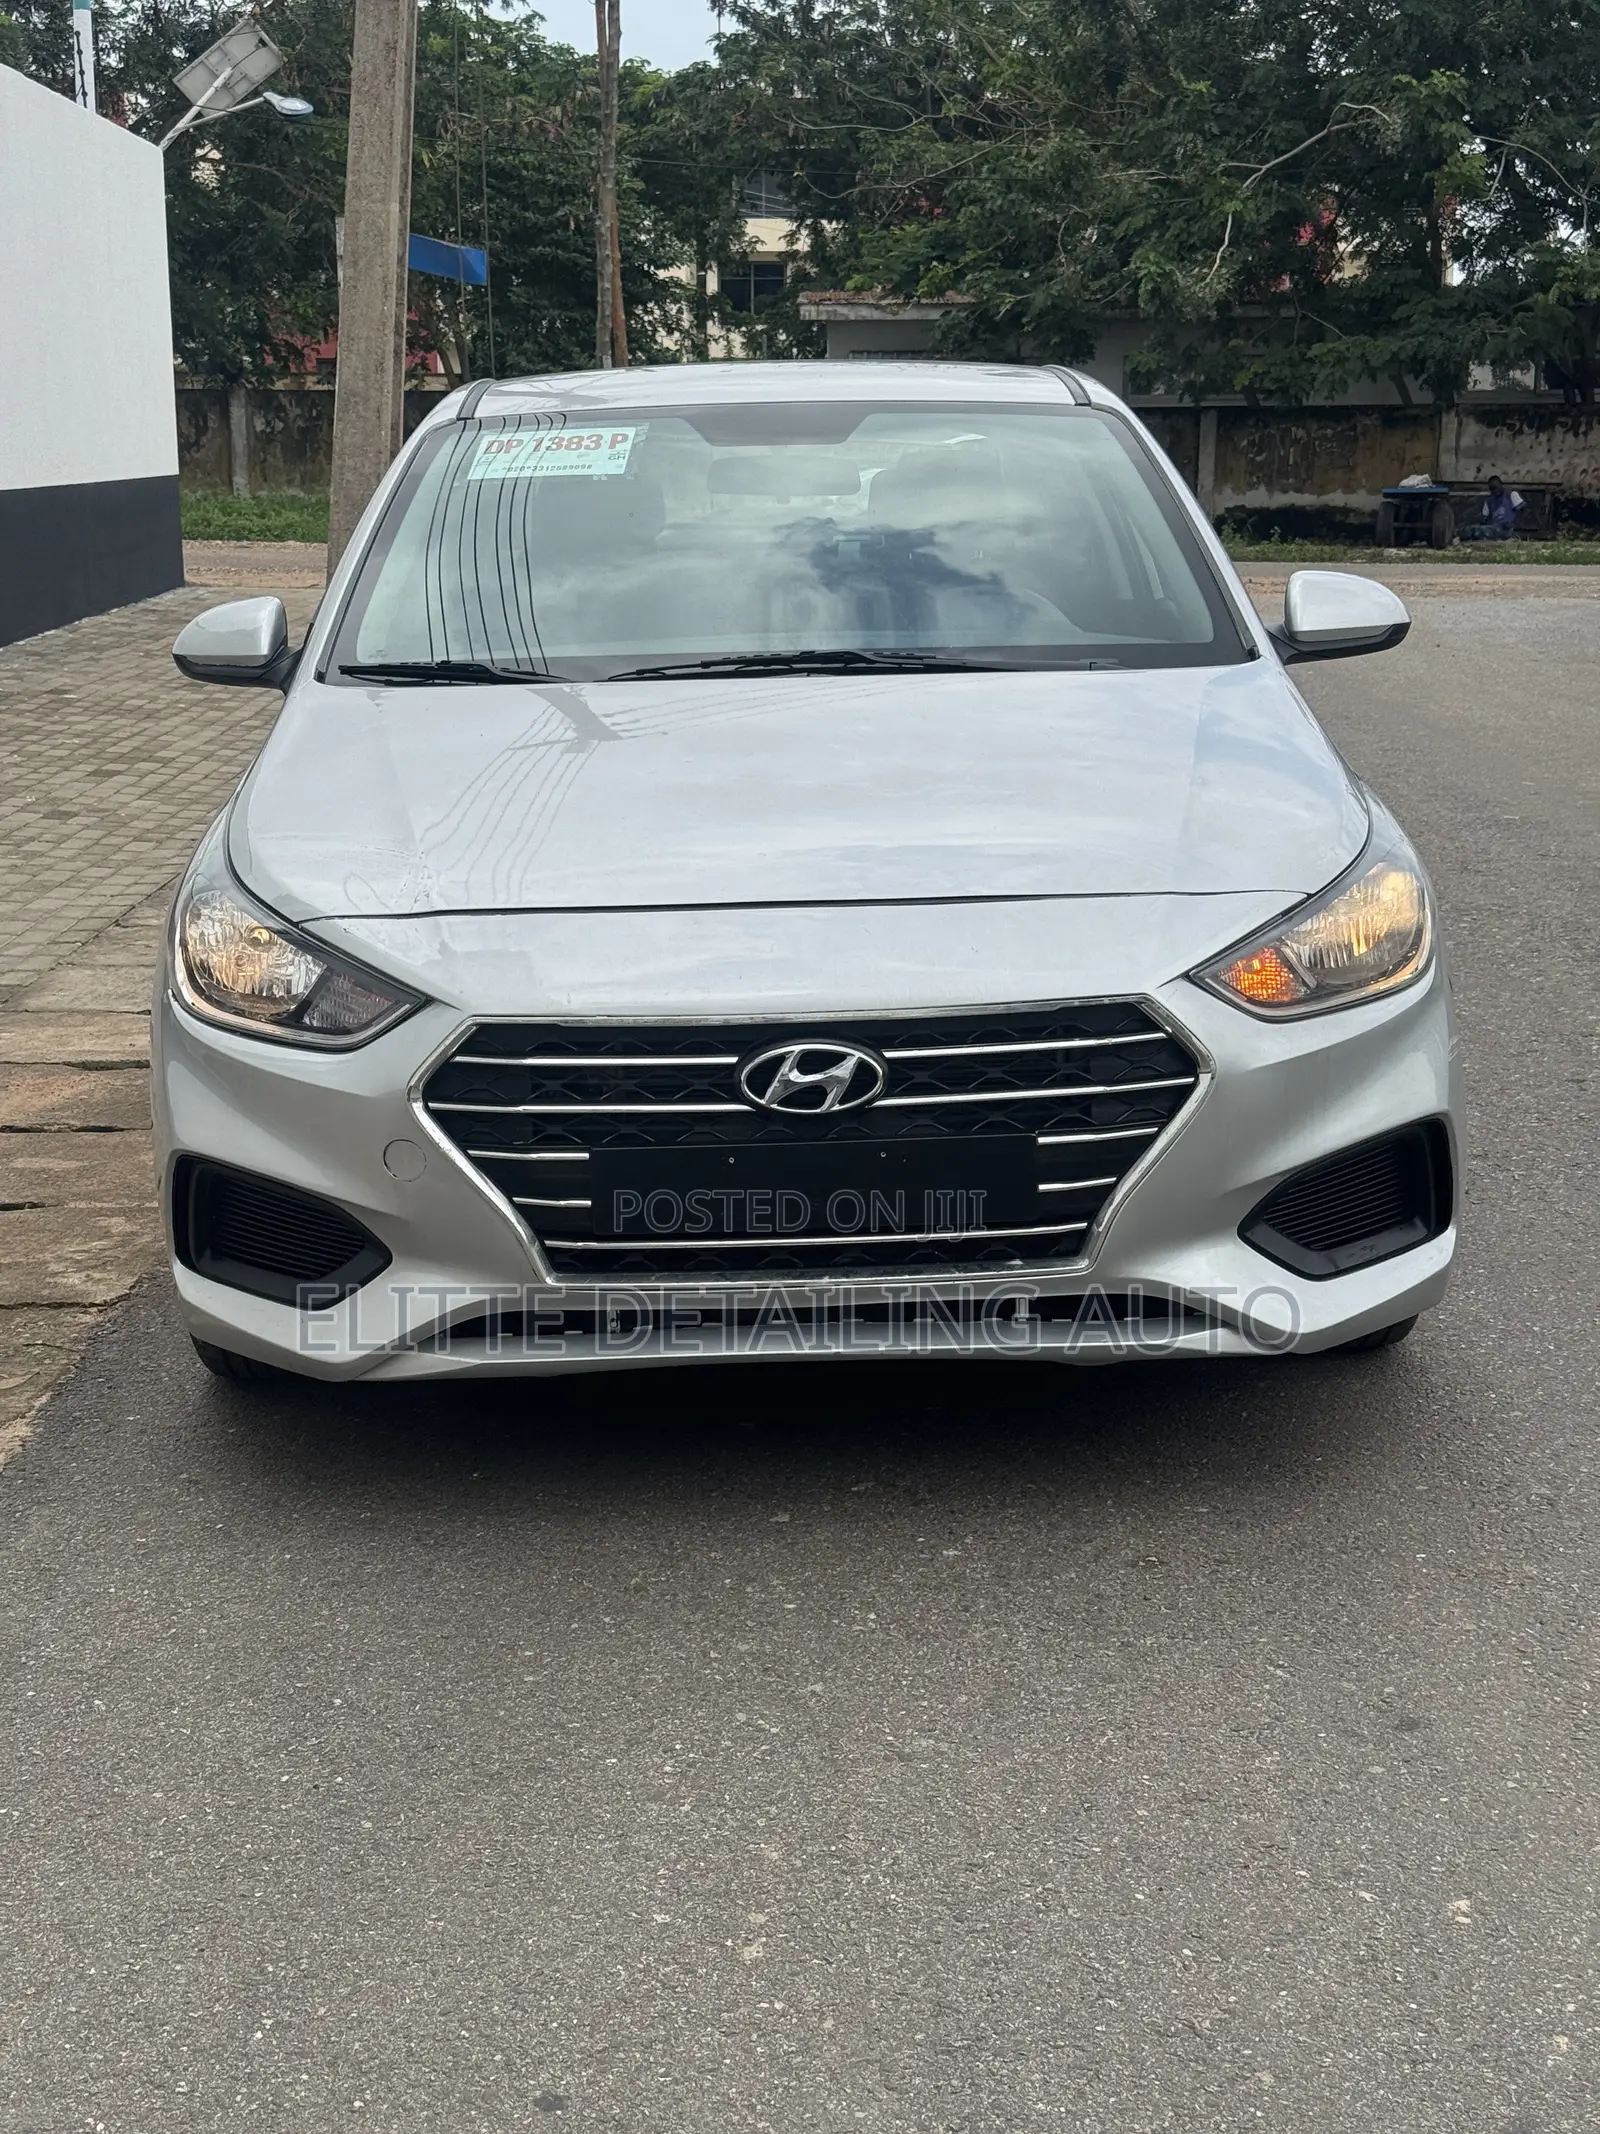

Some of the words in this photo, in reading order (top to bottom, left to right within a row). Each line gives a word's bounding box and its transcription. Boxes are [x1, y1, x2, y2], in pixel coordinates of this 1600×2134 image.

[484, 438, 525, 455] DP
[532, 433, 604, 453] 1383
[607, 432, 630, 450] P
